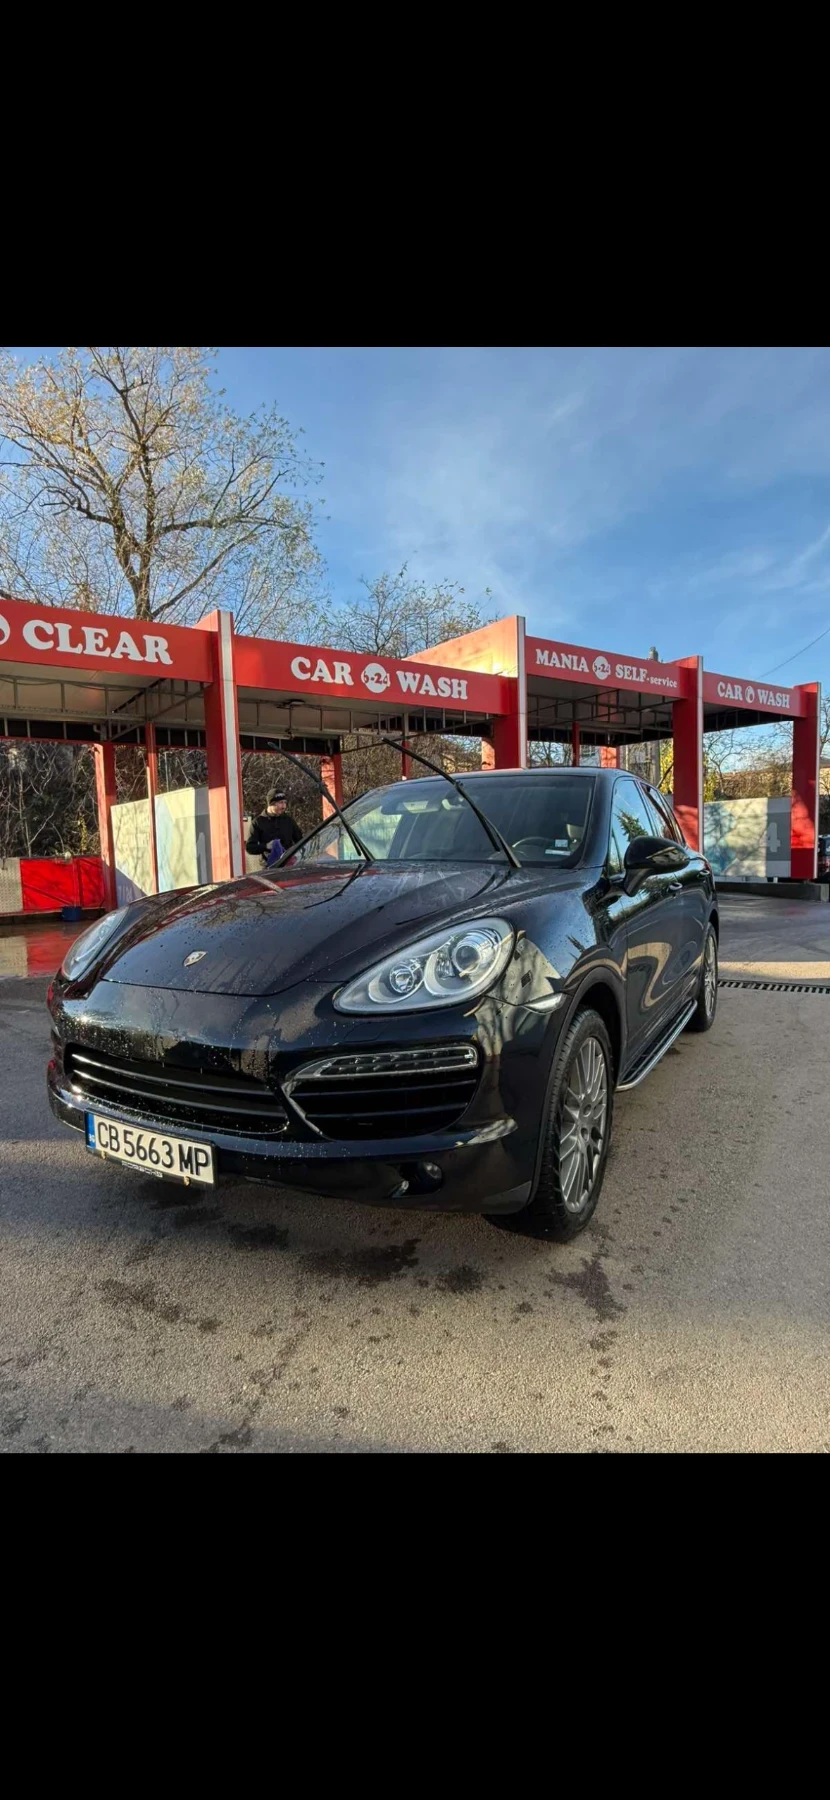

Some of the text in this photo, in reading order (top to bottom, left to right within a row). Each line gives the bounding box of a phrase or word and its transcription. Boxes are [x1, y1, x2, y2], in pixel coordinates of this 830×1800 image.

[22, 619, 173, 665] CLEAR
[535, 649, 589, 673] MANIA
[290, 656, 354, 686] CAR
[395, 670, 468, 700] WASH
[717, 681, 790, 709] CAR WASH
[97, 1121, 209, 1176] CB 5663 MP
